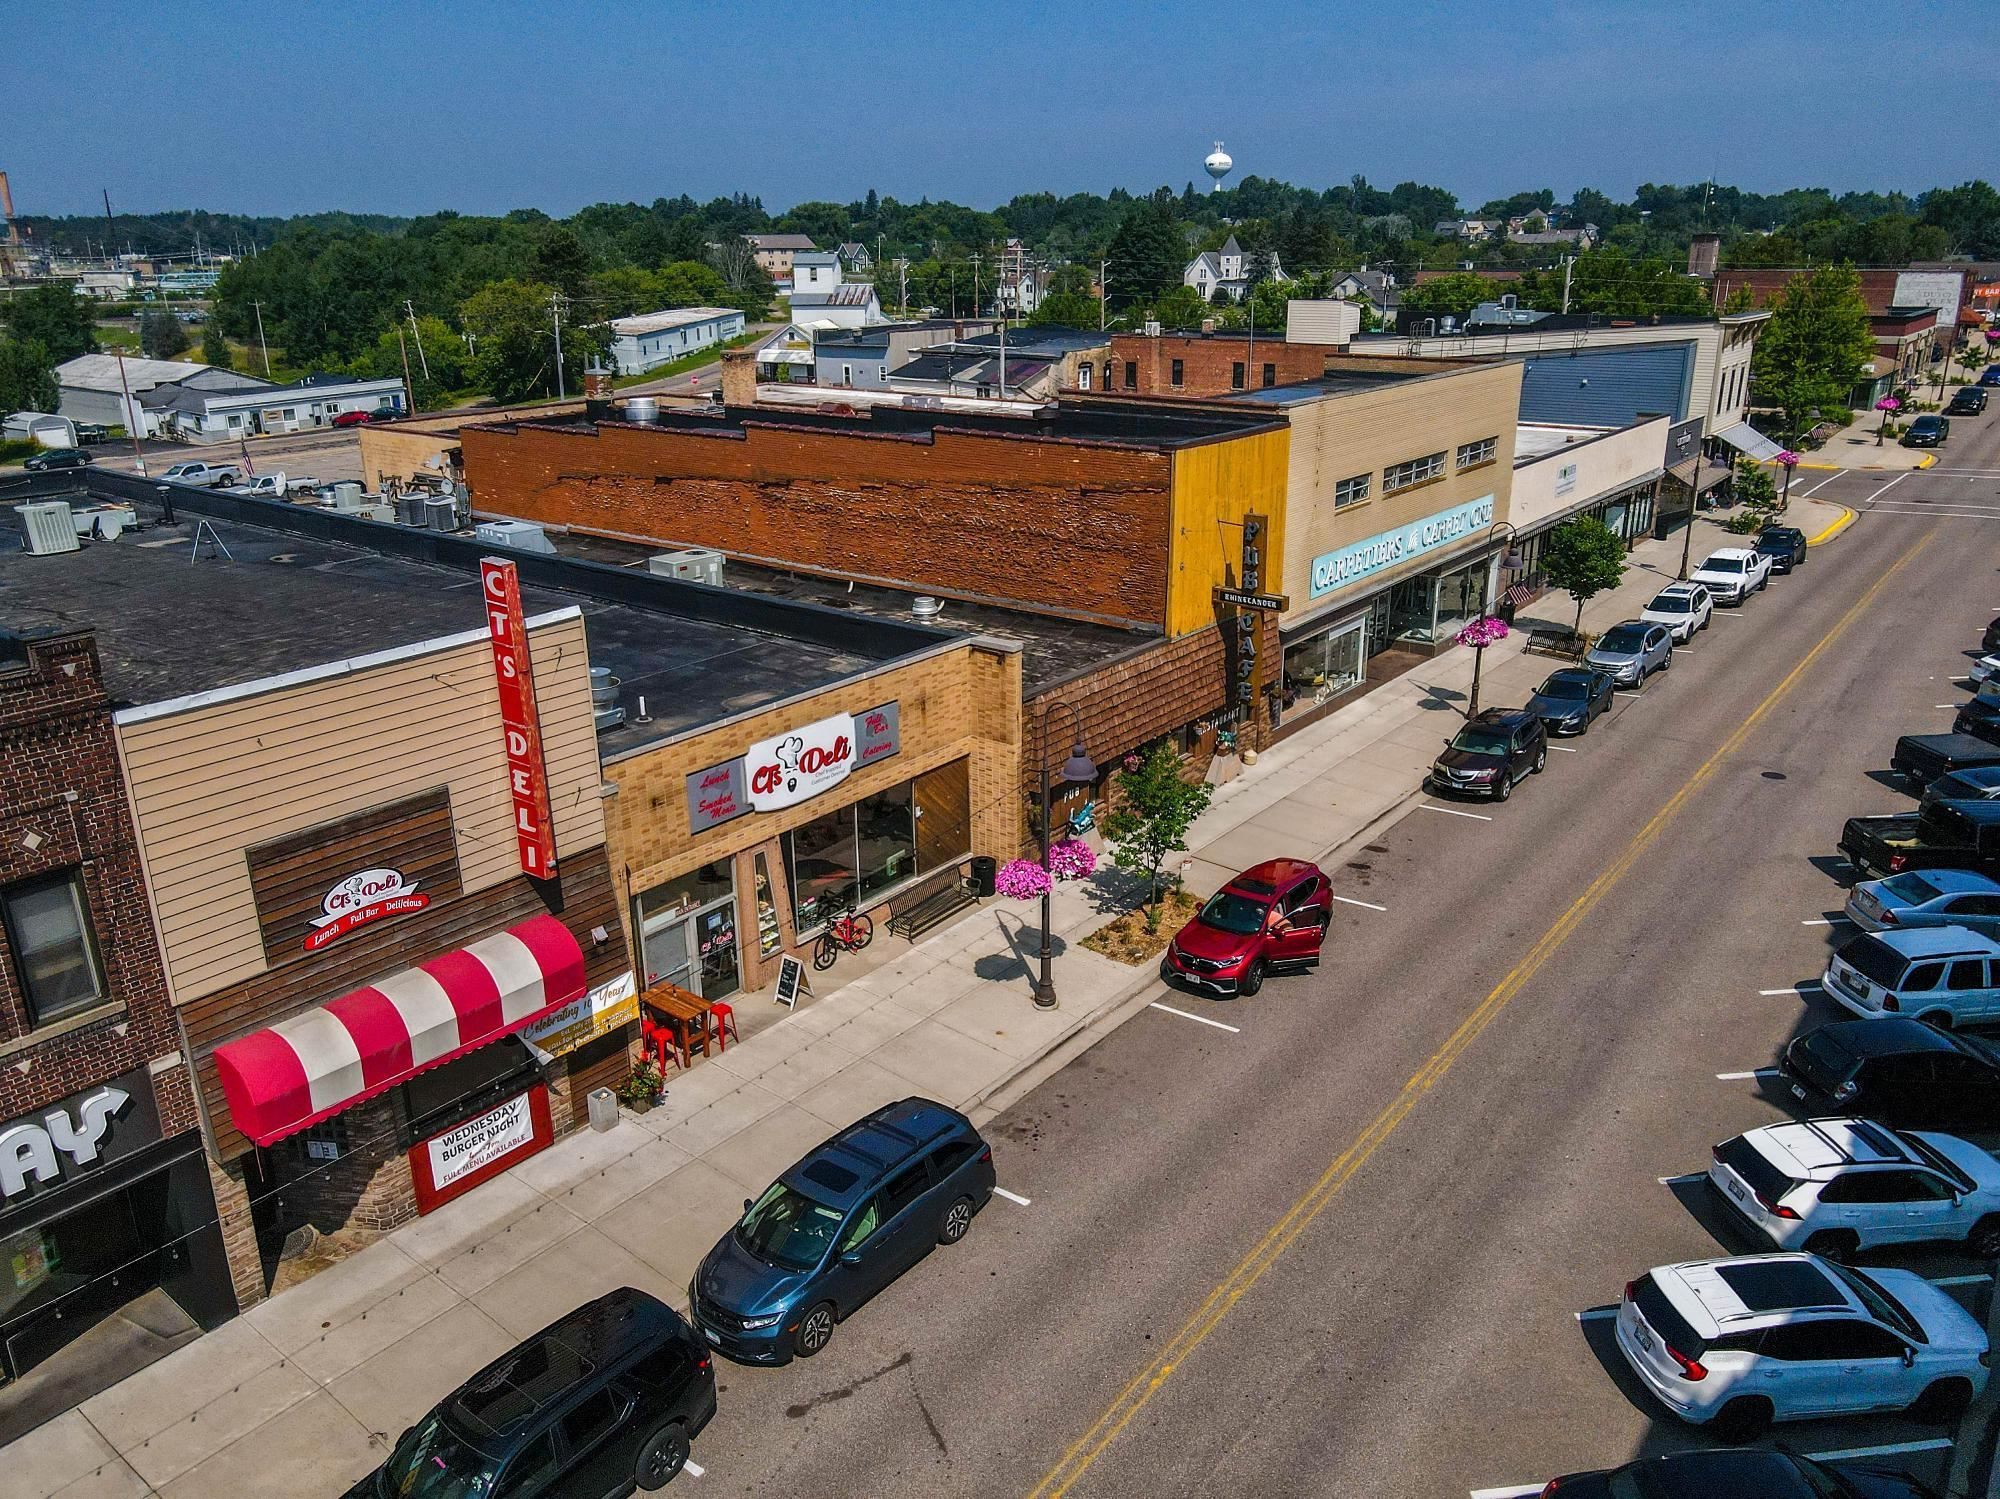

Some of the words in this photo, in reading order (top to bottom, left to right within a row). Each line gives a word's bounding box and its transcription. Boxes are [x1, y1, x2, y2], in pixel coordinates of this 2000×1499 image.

[1422, 512, 1467, 547] CARPET
[1470, 504, 1493, 528] ONE
[1244, 521, 1260, 590] PUB
[1224, 592, 1277, 609] RHINELANDER
[1238, 612, 1258, 701] CAFE
[485, 570, 516, 678] CT'S
[507, 731, 537, 868] DELI
[864, 712, 883, 729] Full
[873, 722, 889, 735] Bar
[799, 735, 852, 774] Deli
[862, 740, 892, 759] Catering
[700, 768, 730, 790] Lunch
[698, 792, 733, 813] Smoked
[711, 804, 737, 819] Meats
[361, 874, 399, 897] Deli
[314, 923, 340, 946] Lunch
[350, 911, 364, 924] Full
[365, 908, 380, 918] Bar
[523, 1005, 579, 1040] Celebrating
[600, 977, 630, 1008] Years
[442, 1102, 517, 1148] WEDNESDAY
[442, 1133, 485, 1162] BURGER
[486, 1114, 520, 1139] NIGHT
[443, 1166, 462, 1183] FULL
[461, 1156, 485, 1173] MENU
[485, 1134, 526, 1161] AVAILABLE
